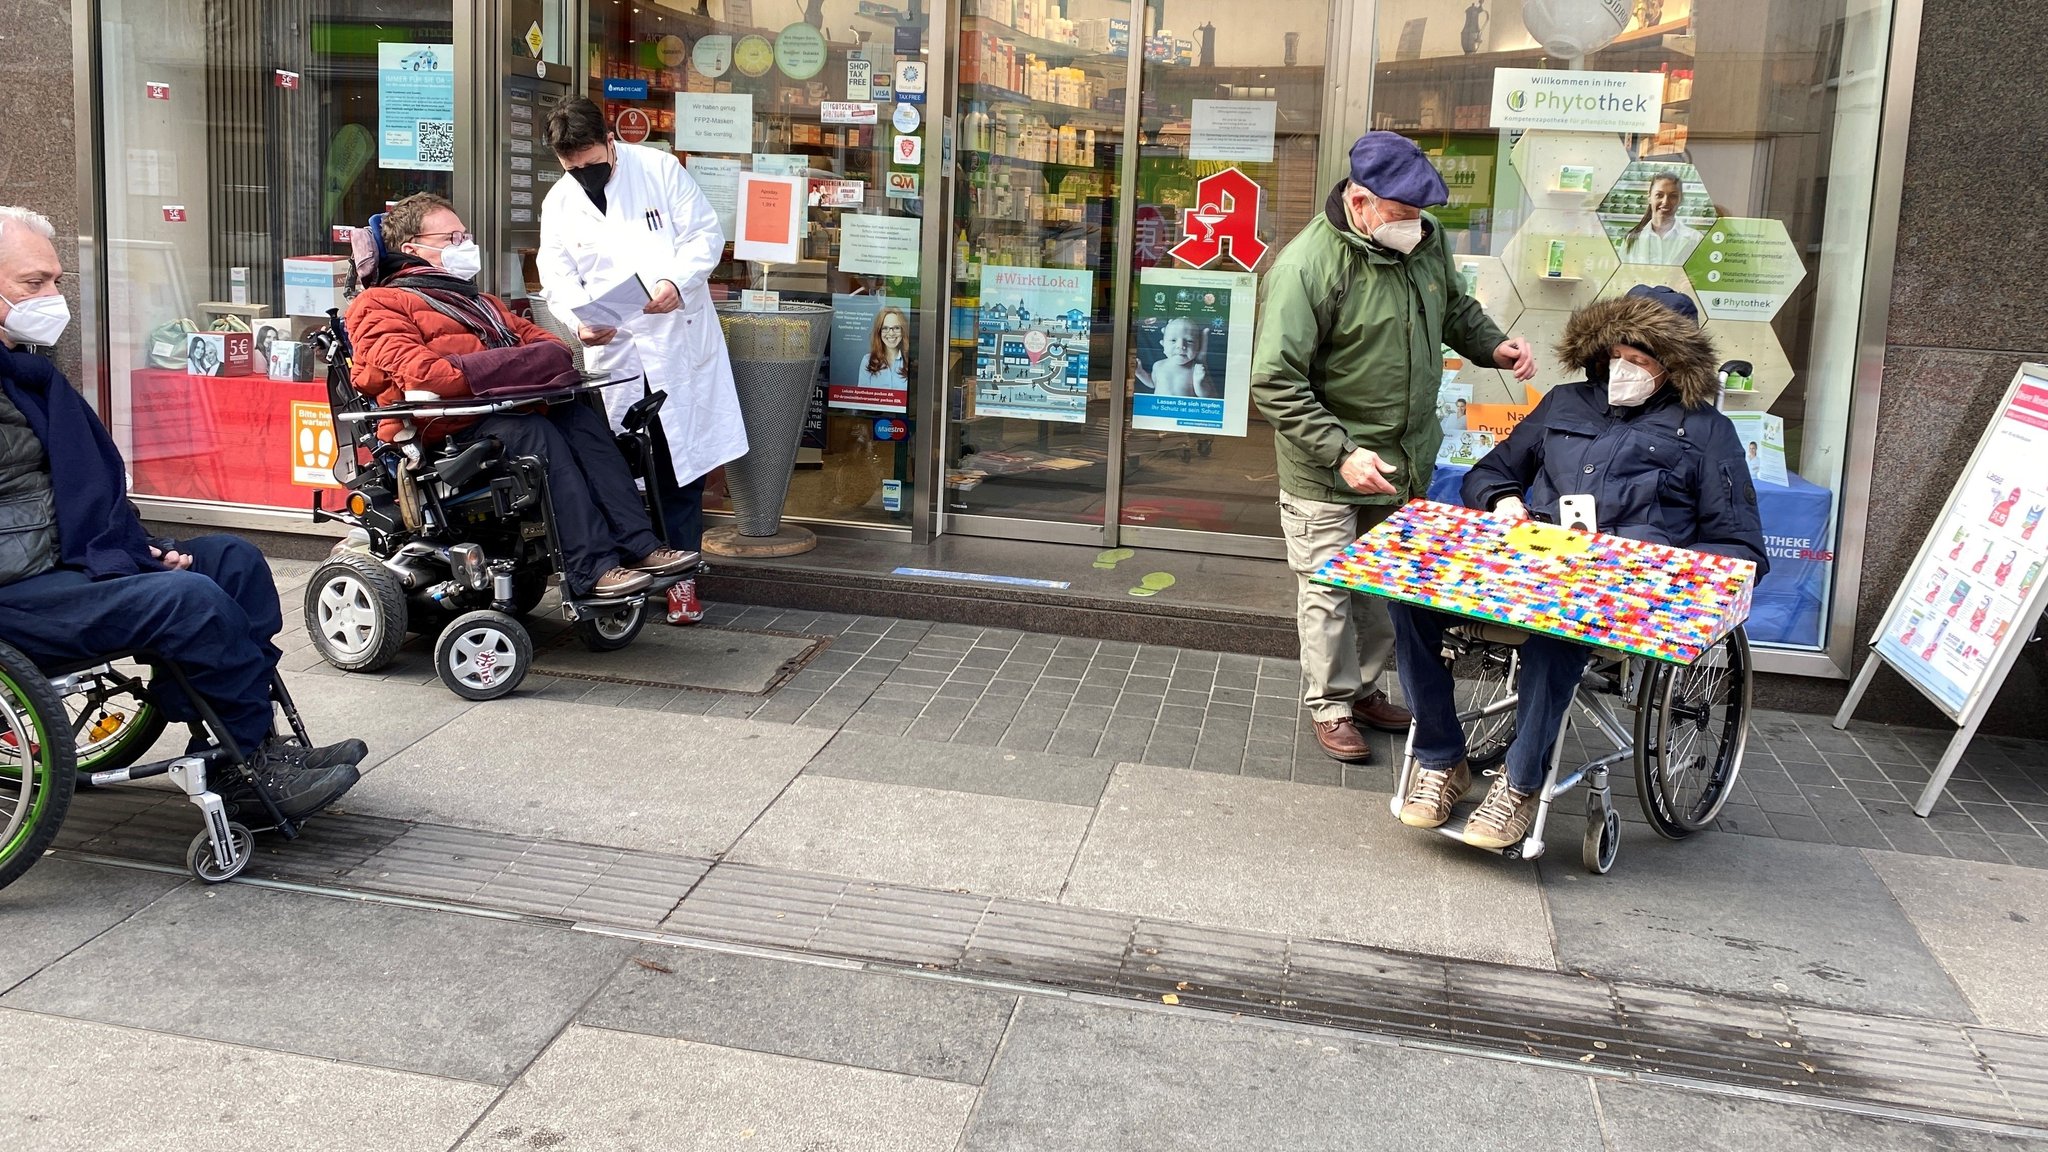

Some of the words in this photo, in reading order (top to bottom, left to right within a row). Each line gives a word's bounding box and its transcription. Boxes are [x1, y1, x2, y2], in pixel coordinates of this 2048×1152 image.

[1111, 20, 1128, 31] Basica
[1176, 39, 1191, 48] Basica
[281, 75, 292, 84] 5€
[1531, 76, 1589, 86] Willkommen
[1592, 78, 1601, 86] in
[1604, 79, 1627, 88] Ihrer
[152, 86, 163, 95] 5€
[874, 89, 890, 97] VISA
[704, 104, 719, 112] haben
[822, 103, 860, 111] CITYGUTSCHEIN
[694, 117, 734, 125] FFP2-Masken
[1504, 115, 1569, 124] Kompetenzapotheke
[890, 174, 915, 190] QM
[169, 209, 179, 217] 5€
[339, 229, 349, 237] 5€
[995, 273, 1079, 290] #WirktLokal
[1723, 298, 1771, 308] Phytothek
[229, 338, 249, 355] 5€
[1156, 398, 1176, 407] Lassen
[1187, 400, 1200, 408] sich
[1160, 405, 1179, 413] Schutz
[299, 410, 317, 418] Bitte
[319, 411, 333, 419] hie
[1507, 411, 1526, 421] Na
[302, 419, 330, 427] warten!
[878, 425, 905, 433] Maestro
[1762, 535, 1811, 549] OTHEKE
[1766, 548, 1833, 562] RVICEPLUS
